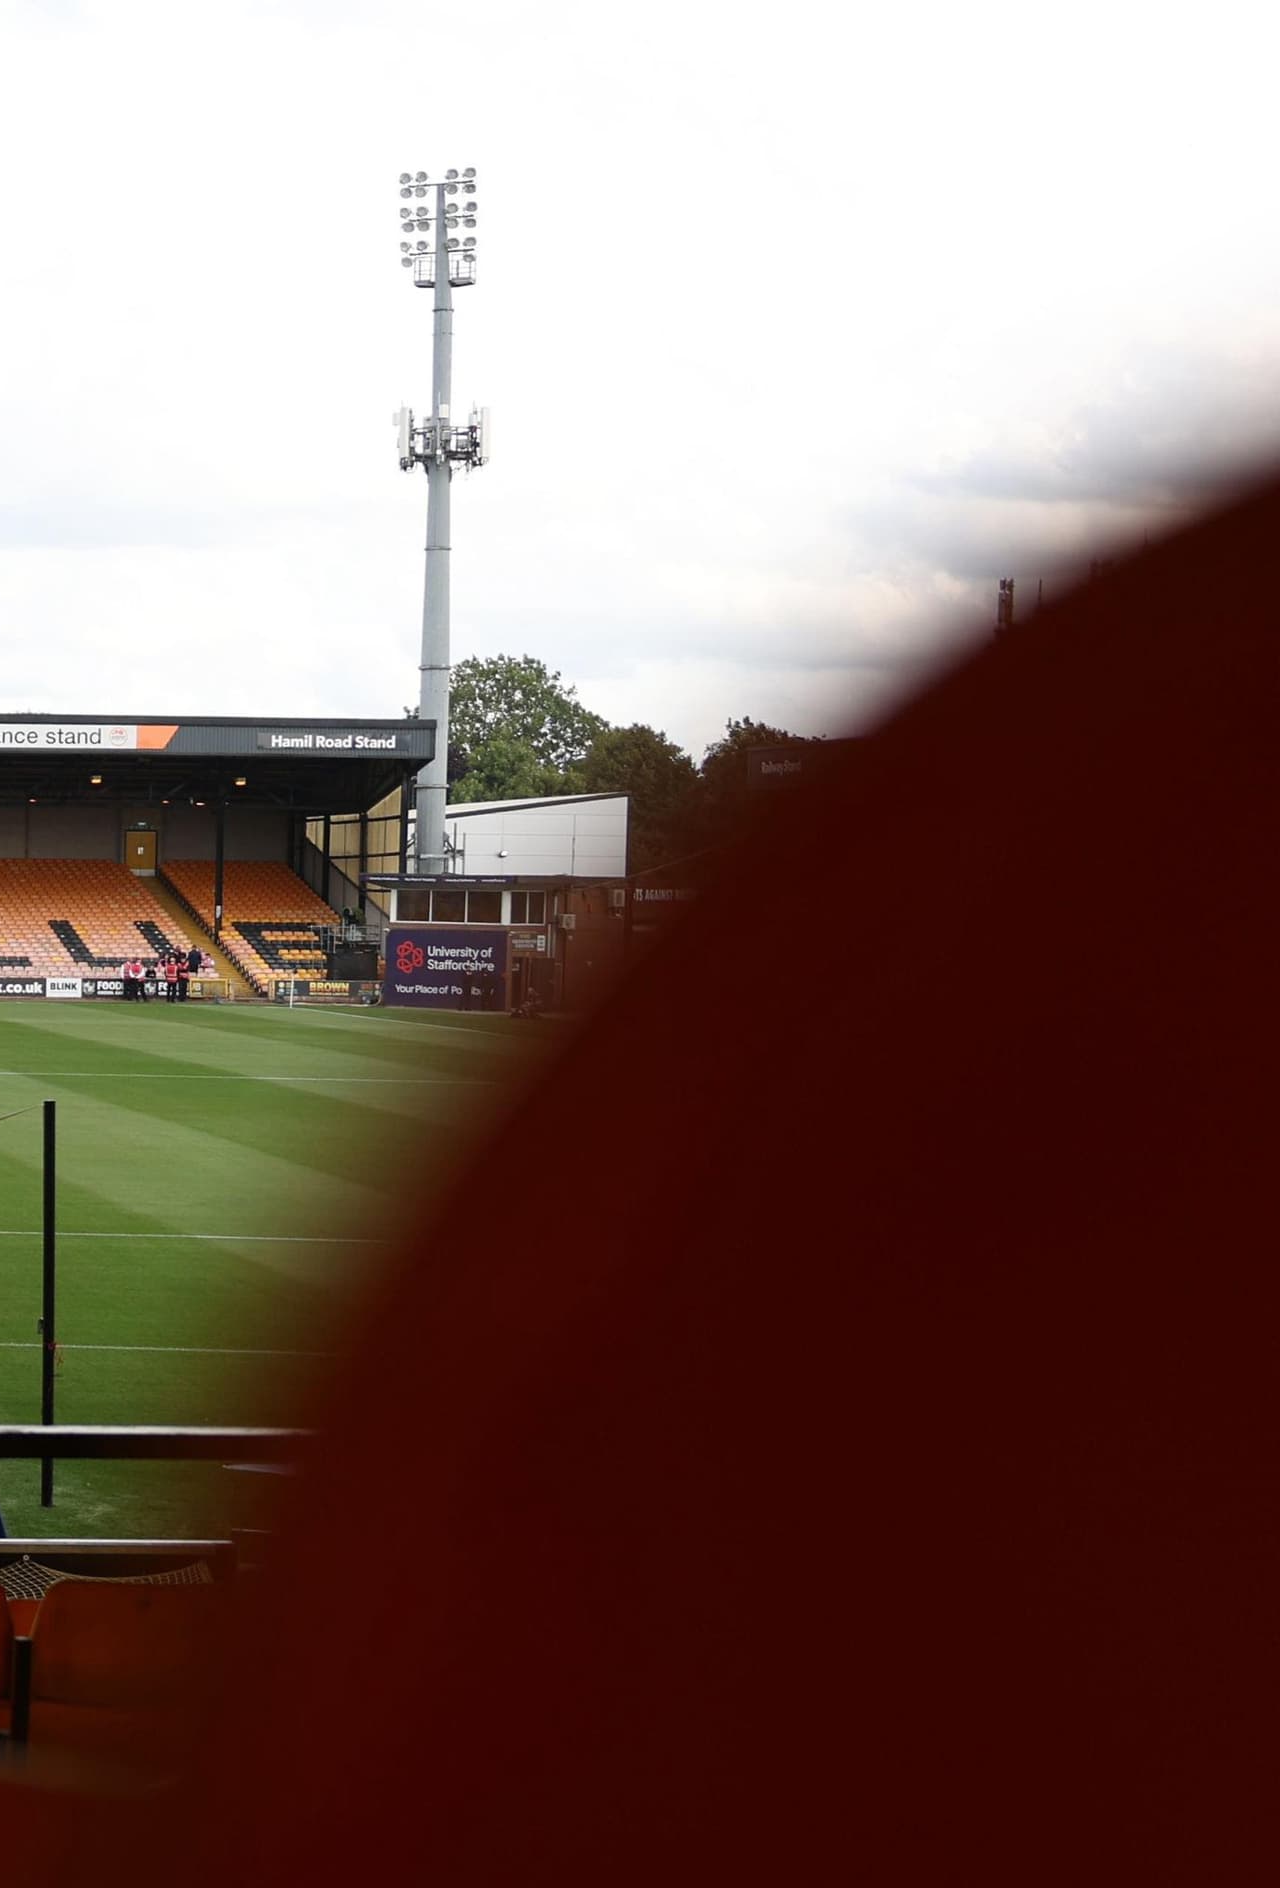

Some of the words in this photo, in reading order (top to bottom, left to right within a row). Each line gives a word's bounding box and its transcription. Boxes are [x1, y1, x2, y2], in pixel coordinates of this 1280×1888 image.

[45, 728, 102, 744] stand
[271, 735, 312, 748] Hamil
[315, 735, 353, 748] Road
[355, 735, 396, 749] Stand
[427, 945, 479, 960] University
[480, 946, 493, 958] of
[427, 959, 495, 971] Staffordshire
[309, 982, 349, 992] BROWN
[395, 984, 414, 994] Your
[415, 985, 438, 994] Place
[439, 985, 448, 994] of
